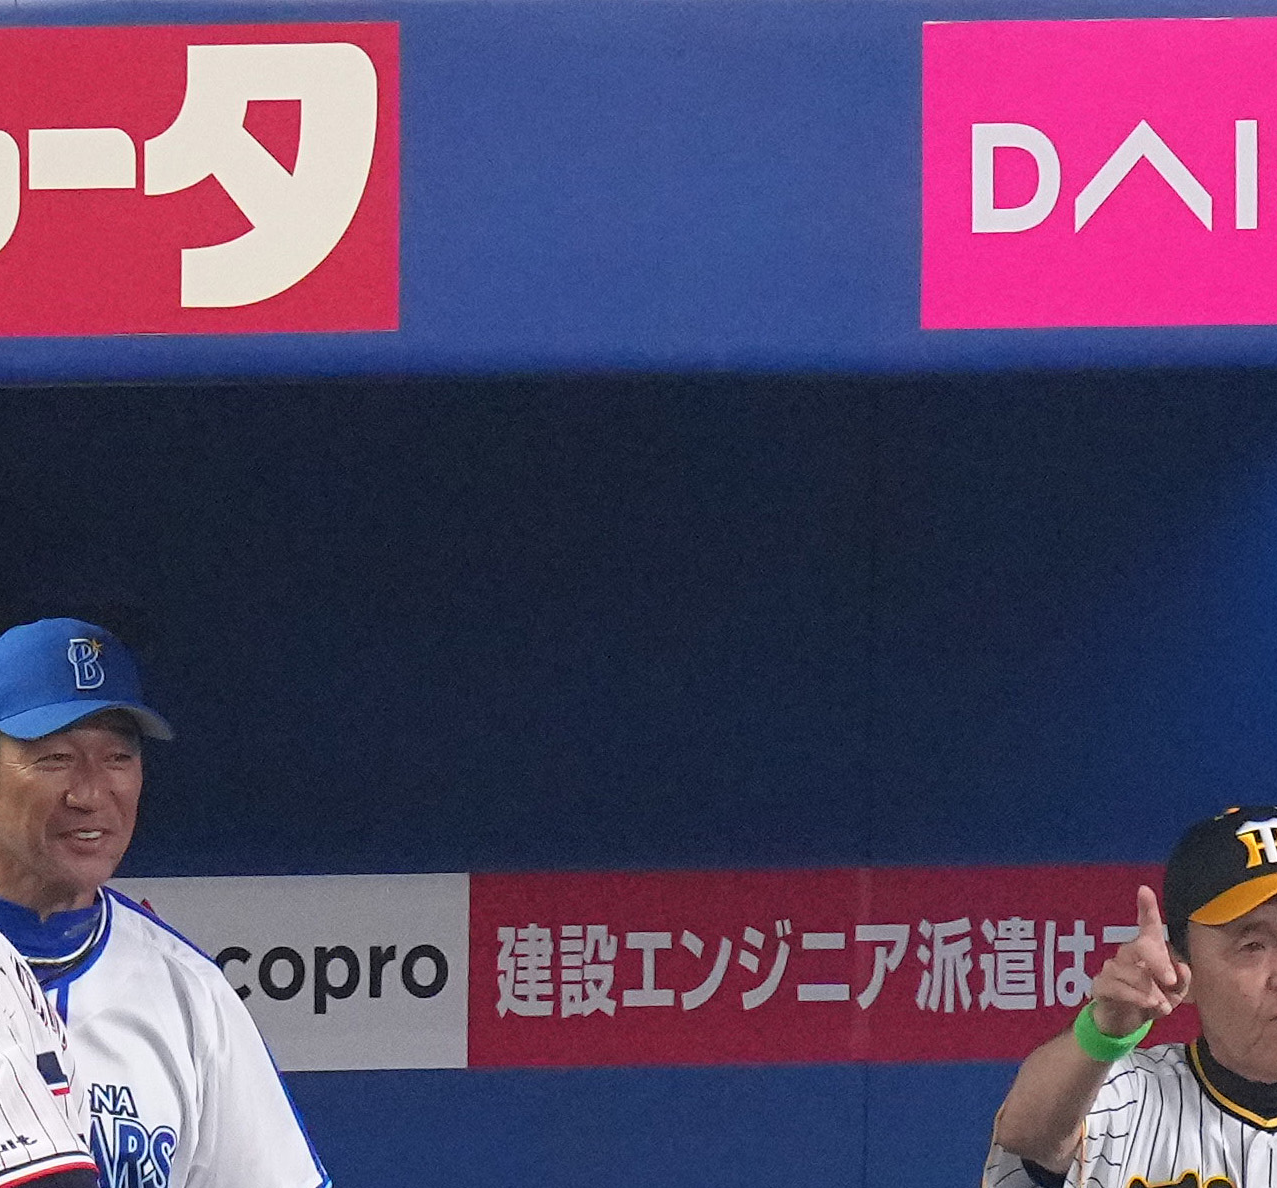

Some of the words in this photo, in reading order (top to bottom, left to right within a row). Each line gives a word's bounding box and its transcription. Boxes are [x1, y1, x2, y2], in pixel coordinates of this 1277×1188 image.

[67, 638, 105, 690] B
[216, 945, 448, 1014] copro
[496, 916, 1169, 1018] 建設エンジニア派遣は
